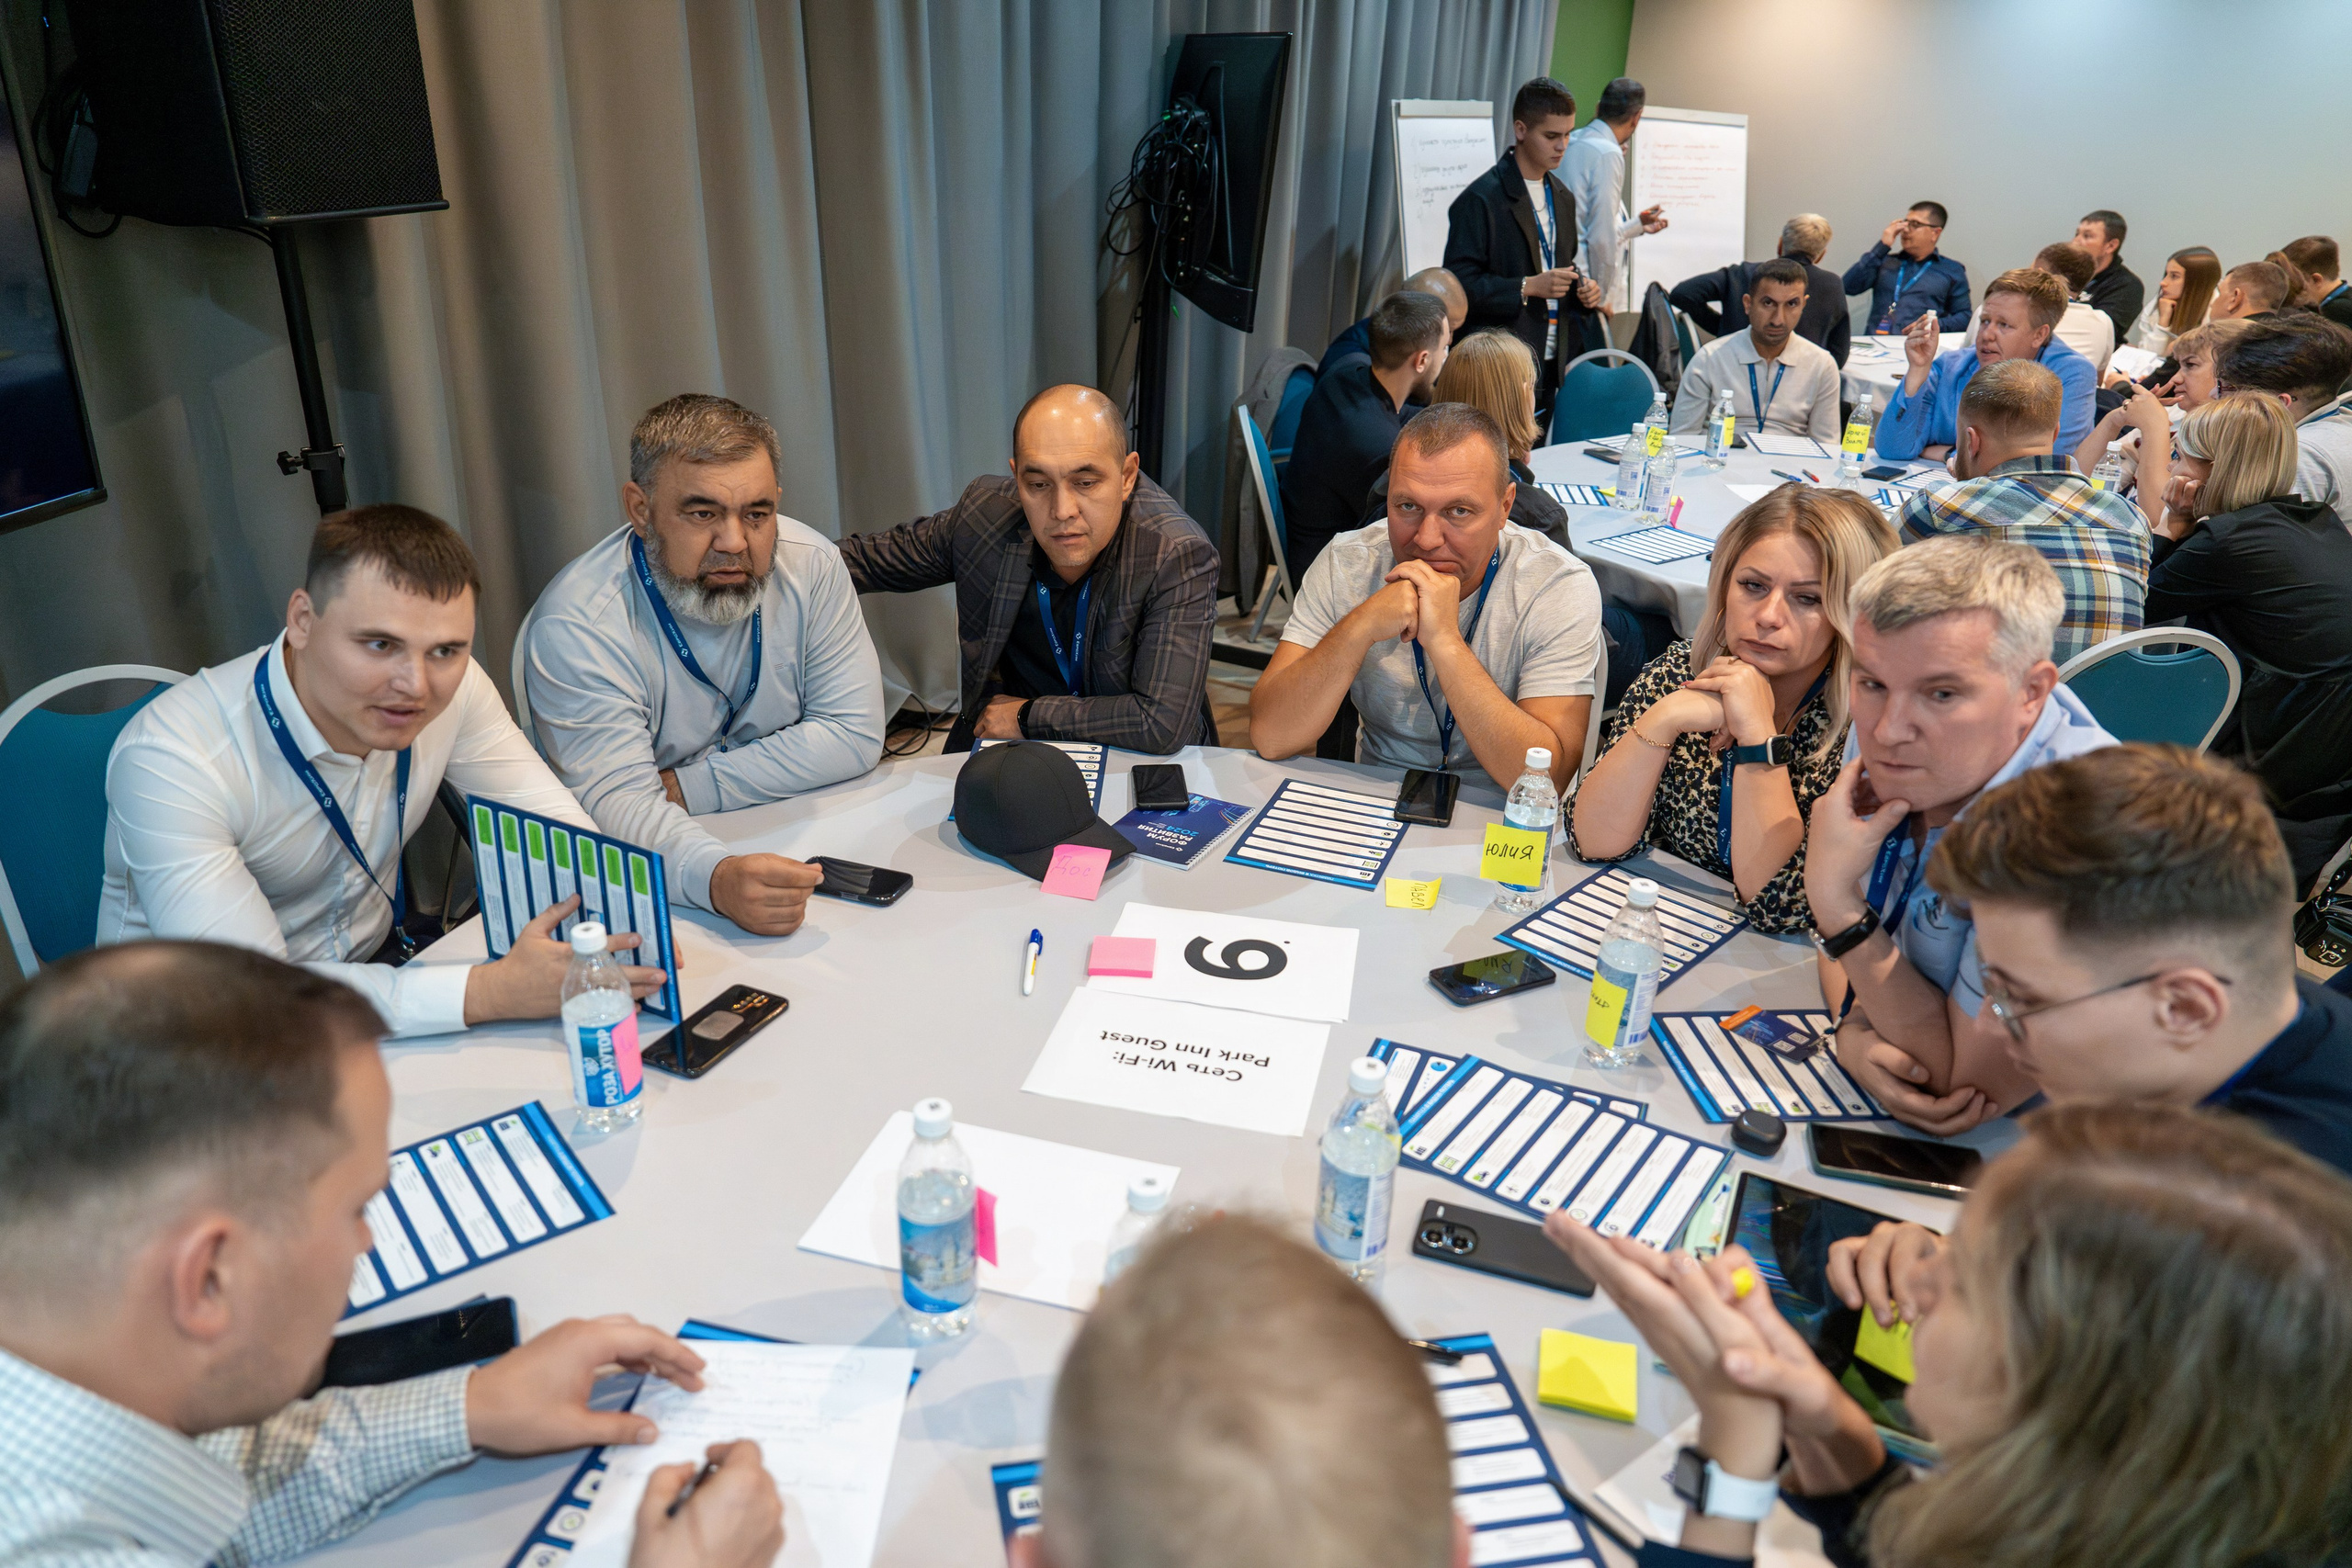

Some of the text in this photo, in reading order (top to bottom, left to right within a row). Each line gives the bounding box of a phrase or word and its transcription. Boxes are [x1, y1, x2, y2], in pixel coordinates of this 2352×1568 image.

[1137, 824, 1193, 841] РАЗВИТИЯ
[1147, 832, 1188, 846] ФОРУМ
[1166, 825, 1199, 837] 2024
[1486, 843, 1533, 860] ЮЛИЯ
[1100, 1030, 1271, 1067] Park Inn Guest
[596, 1029, 619, 1105] РОЗА ХУТОР
[1113, 1051, 1243, 1082] Сеть Wi-Fi:
